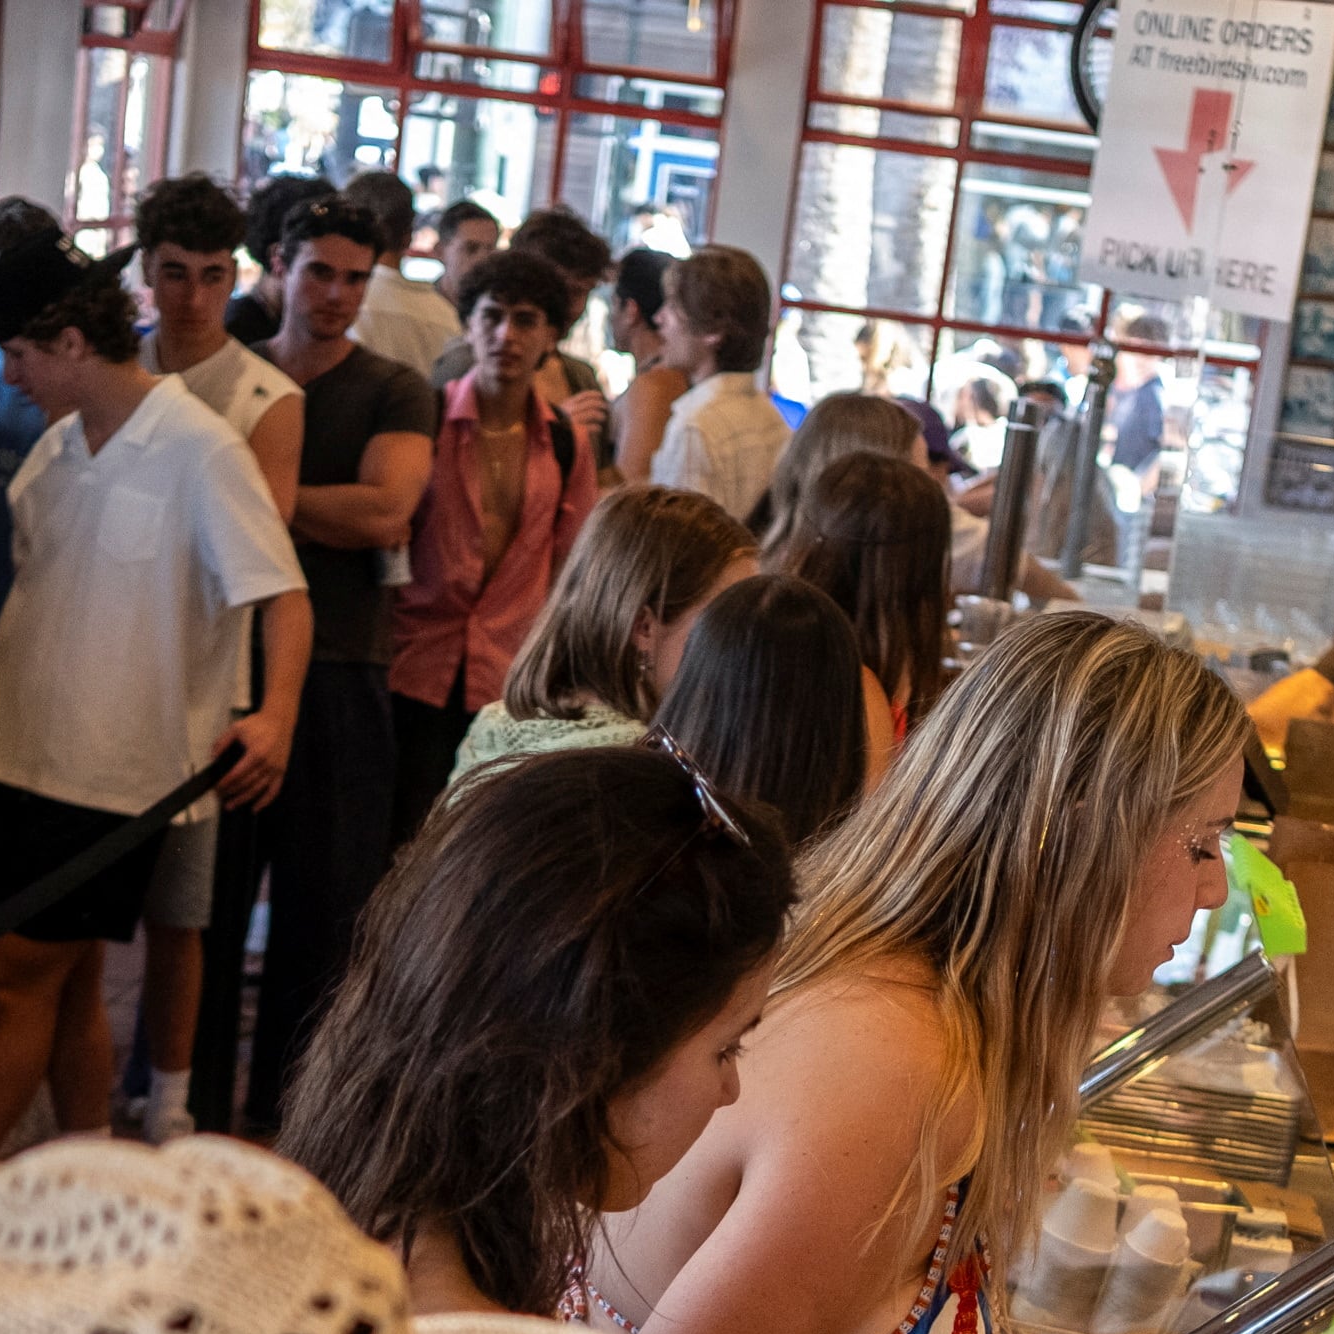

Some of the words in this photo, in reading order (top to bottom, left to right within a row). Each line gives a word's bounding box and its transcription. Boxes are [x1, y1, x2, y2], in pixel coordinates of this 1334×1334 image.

[1133, 10, 1216, 44] ONLINE
[1220, 19, 1313, 56] ORDERS
[1129, 44, 1154, 66] AT
[1099, 237, 1158, 276] PICK
